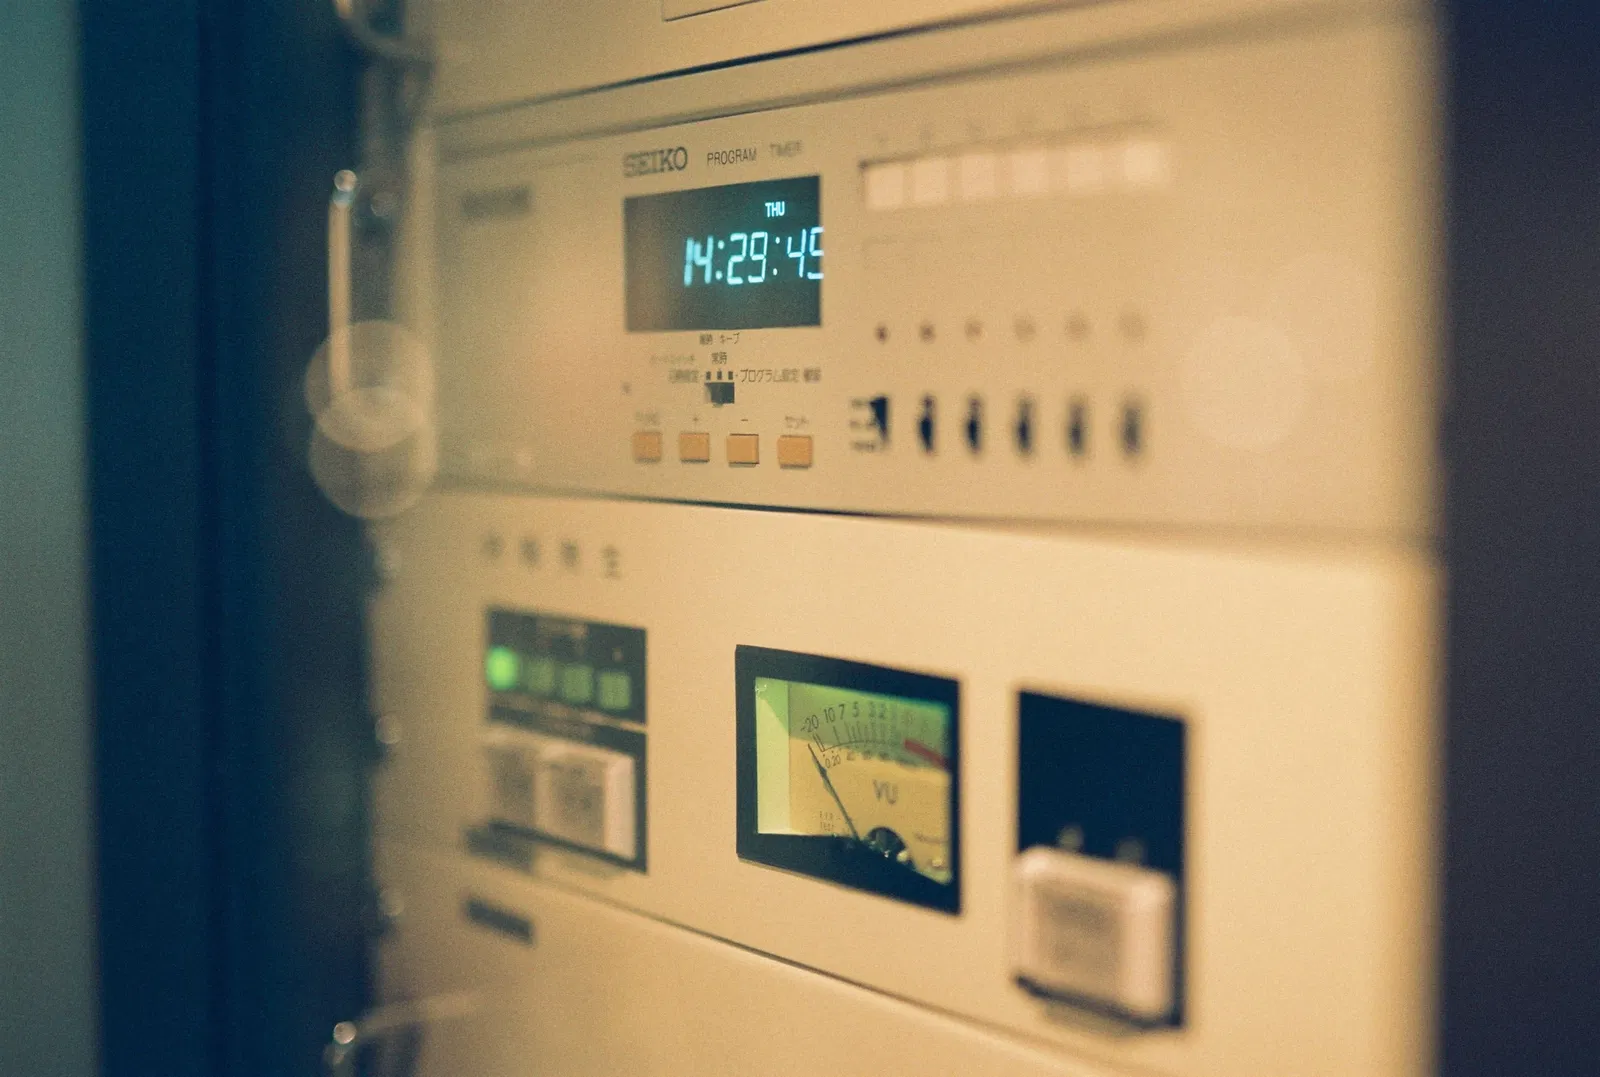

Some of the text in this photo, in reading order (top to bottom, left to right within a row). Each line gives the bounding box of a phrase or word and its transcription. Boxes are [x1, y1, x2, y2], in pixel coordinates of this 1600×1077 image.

[623, 146, 688, 177] SEIKO
[707, 147, 757, 166] PROGRAM
[765, 201, 786, 217] THU
[824, 707, 836, 723] 10
[839, 703, 846, 720] 7
[872, 779, 900, 805] VU
